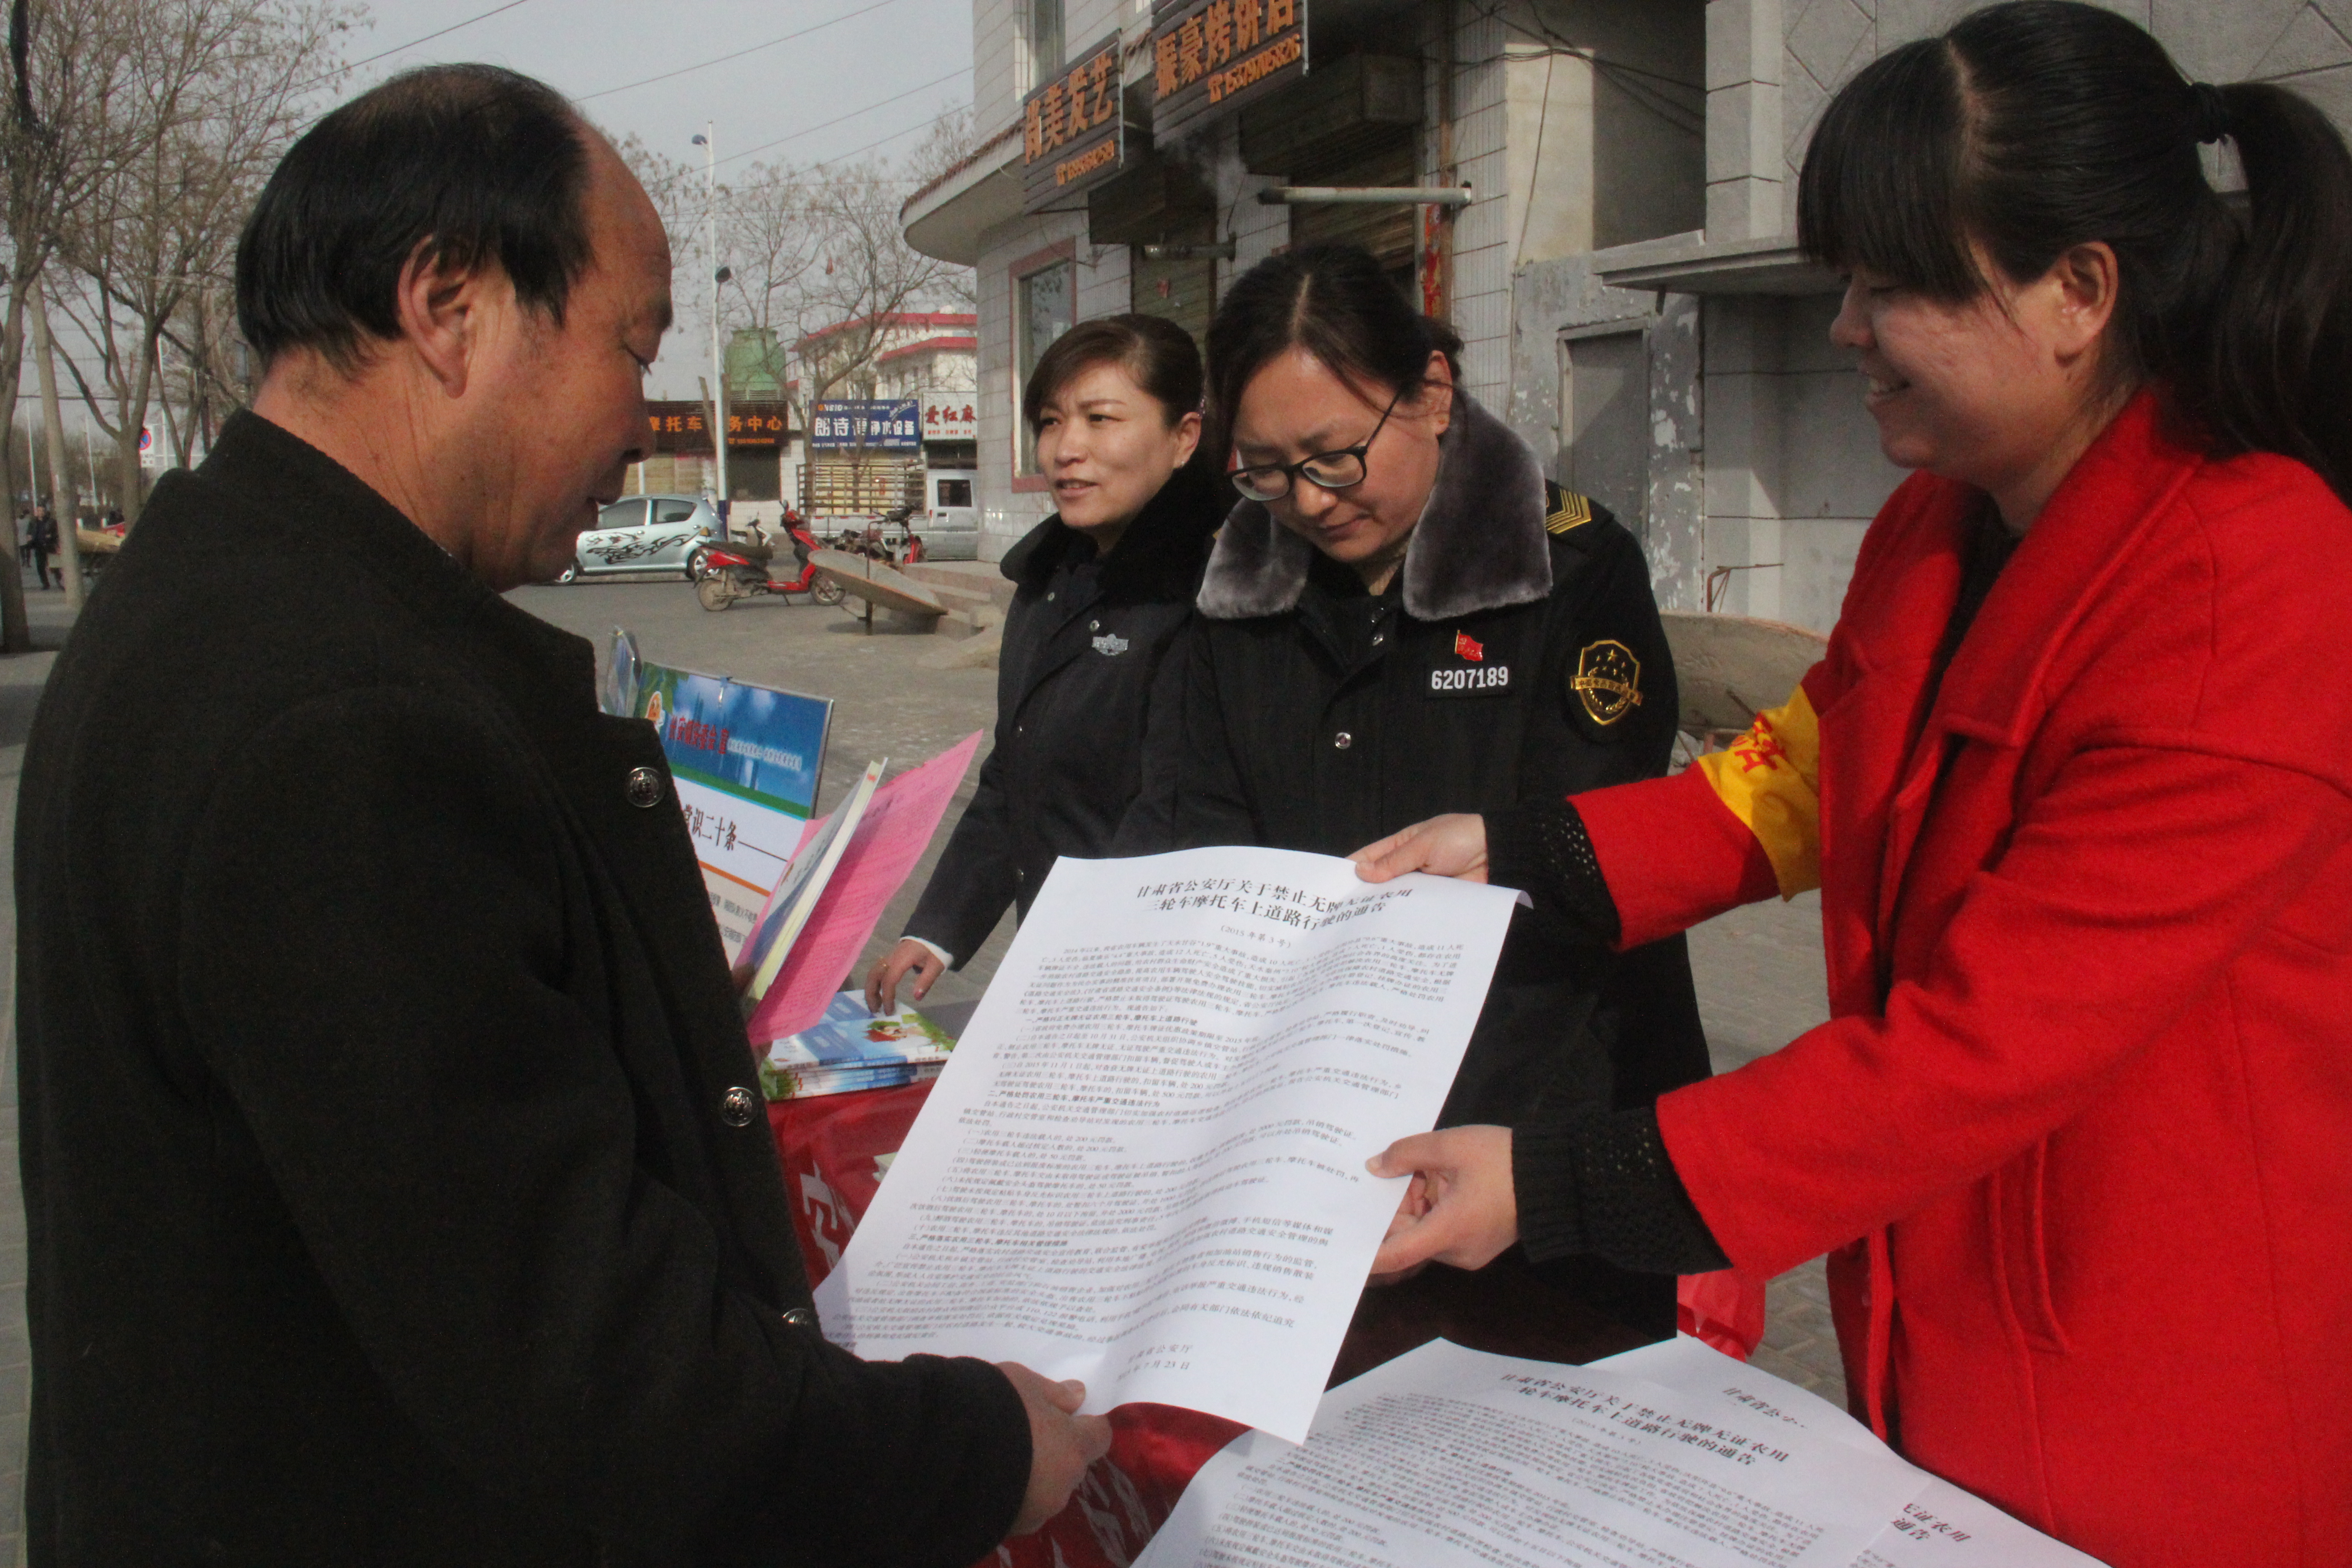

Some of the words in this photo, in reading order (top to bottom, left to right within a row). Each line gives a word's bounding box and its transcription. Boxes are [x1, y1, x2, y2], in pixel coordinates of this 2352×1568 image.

[1431, 666, 1509, 690] 6207189
[1137, 878, 1413, 913] 甘肃省公安厅关于禁止无牌无证农用
[1146, 894, 1387, 931] 三轮车摩托车上道路行驶的通告
[1500, 1373, 1789, 1463] 甘肃省公安厅关于禁止无牌无证农用
[1514, 1386, 1756, 1466] 轮车摩托车上道路行驶的通告
[1891, 1518, 1930, 1540] 通告
